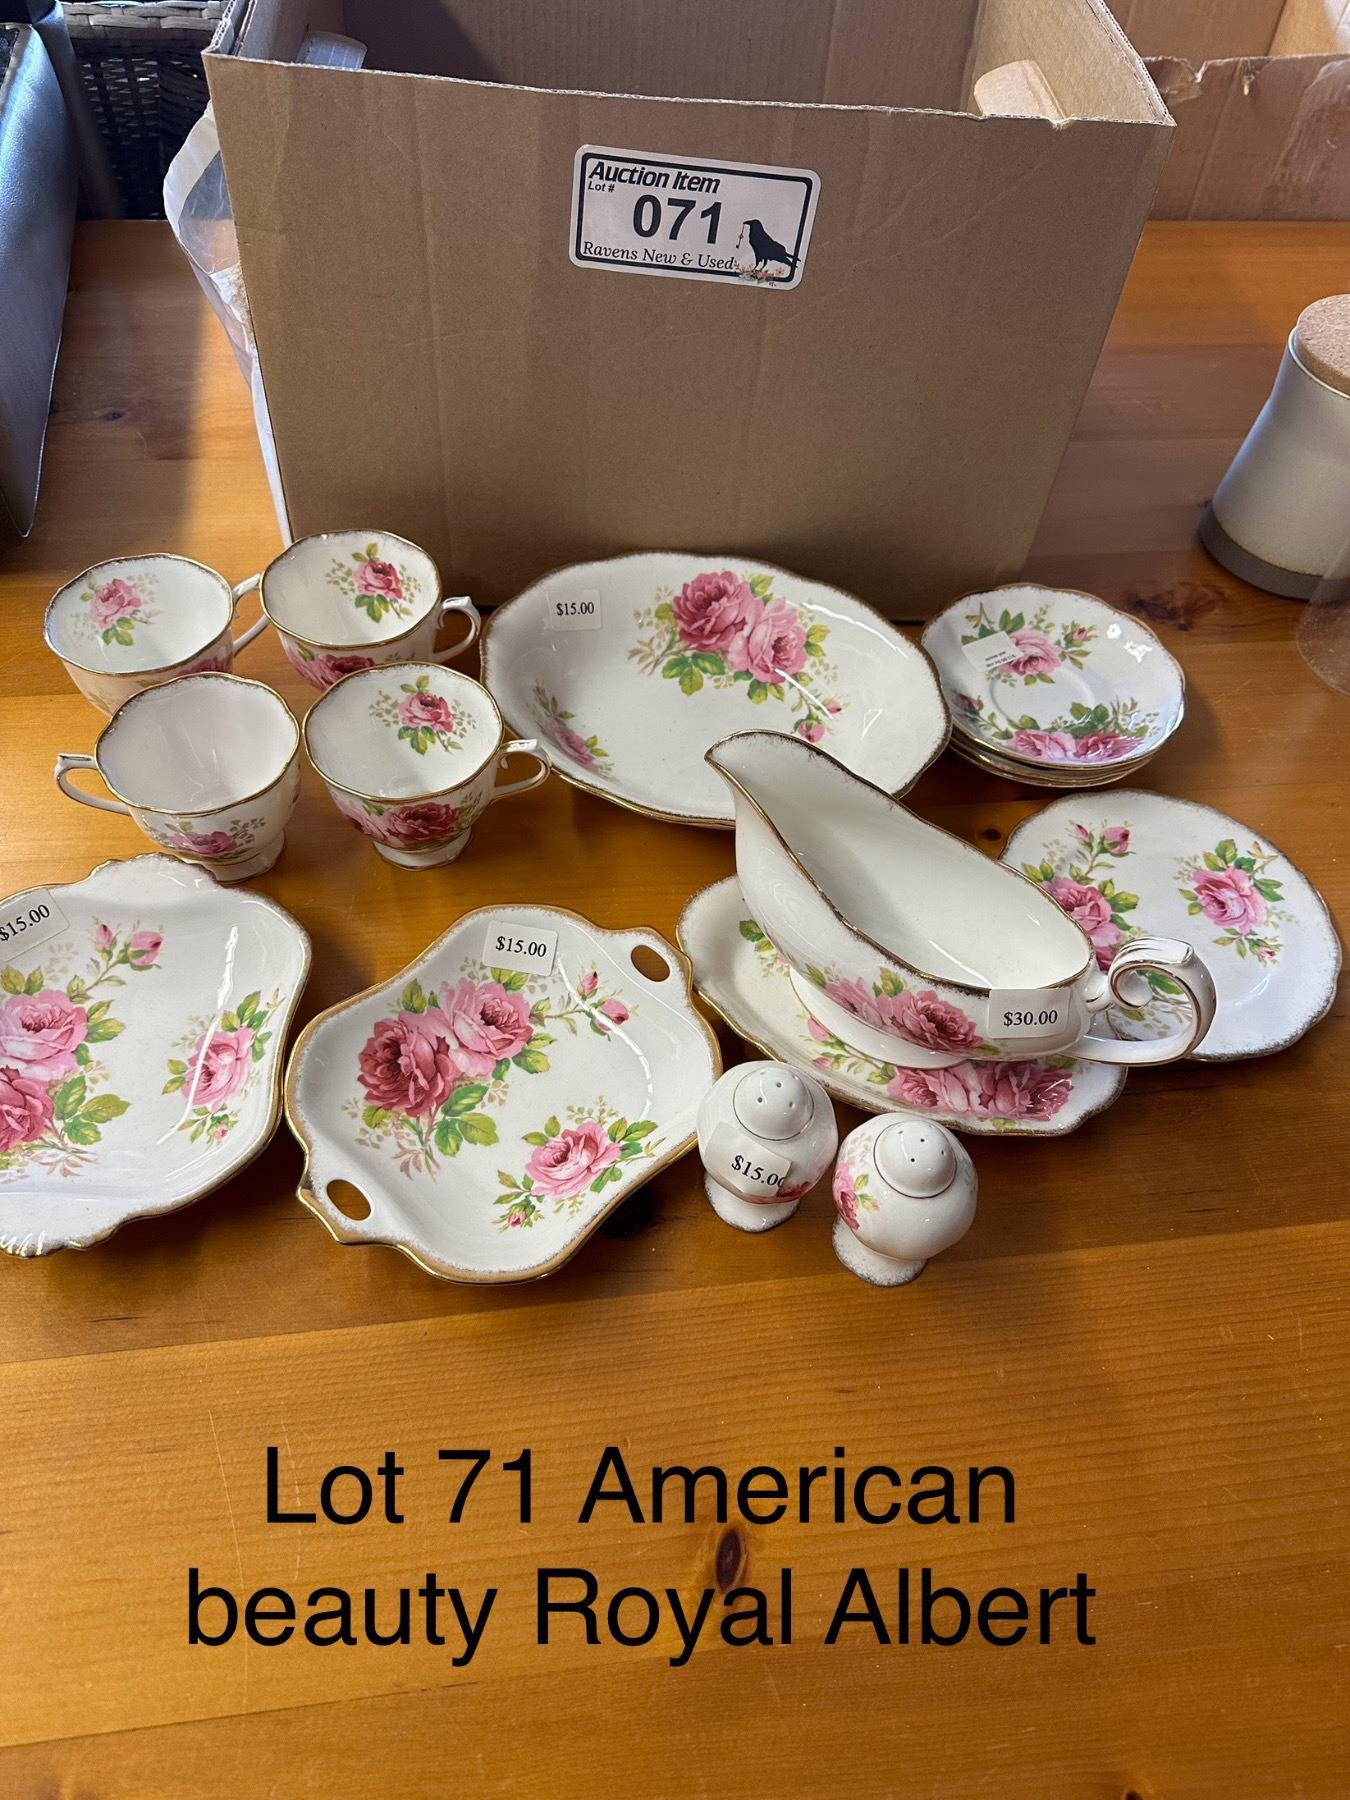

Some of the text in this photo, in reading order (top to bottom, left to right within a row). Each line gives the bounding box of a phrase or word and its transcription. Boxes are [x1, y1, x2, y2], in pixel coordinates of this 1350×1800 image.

[588, 160, 721, 194] Auction Item
[588, 181, 615, 193] Lot #
[632, 194, 722, 245] 071
[583, 241, 735, 270] Ravens New & Used
[556, 602, 594, 616] $15.00
[0, 904, 50, 941] $15.00
[496, 936, 547, 957] $15.00
[1003, 1010, 1058, 1027] $30.00
